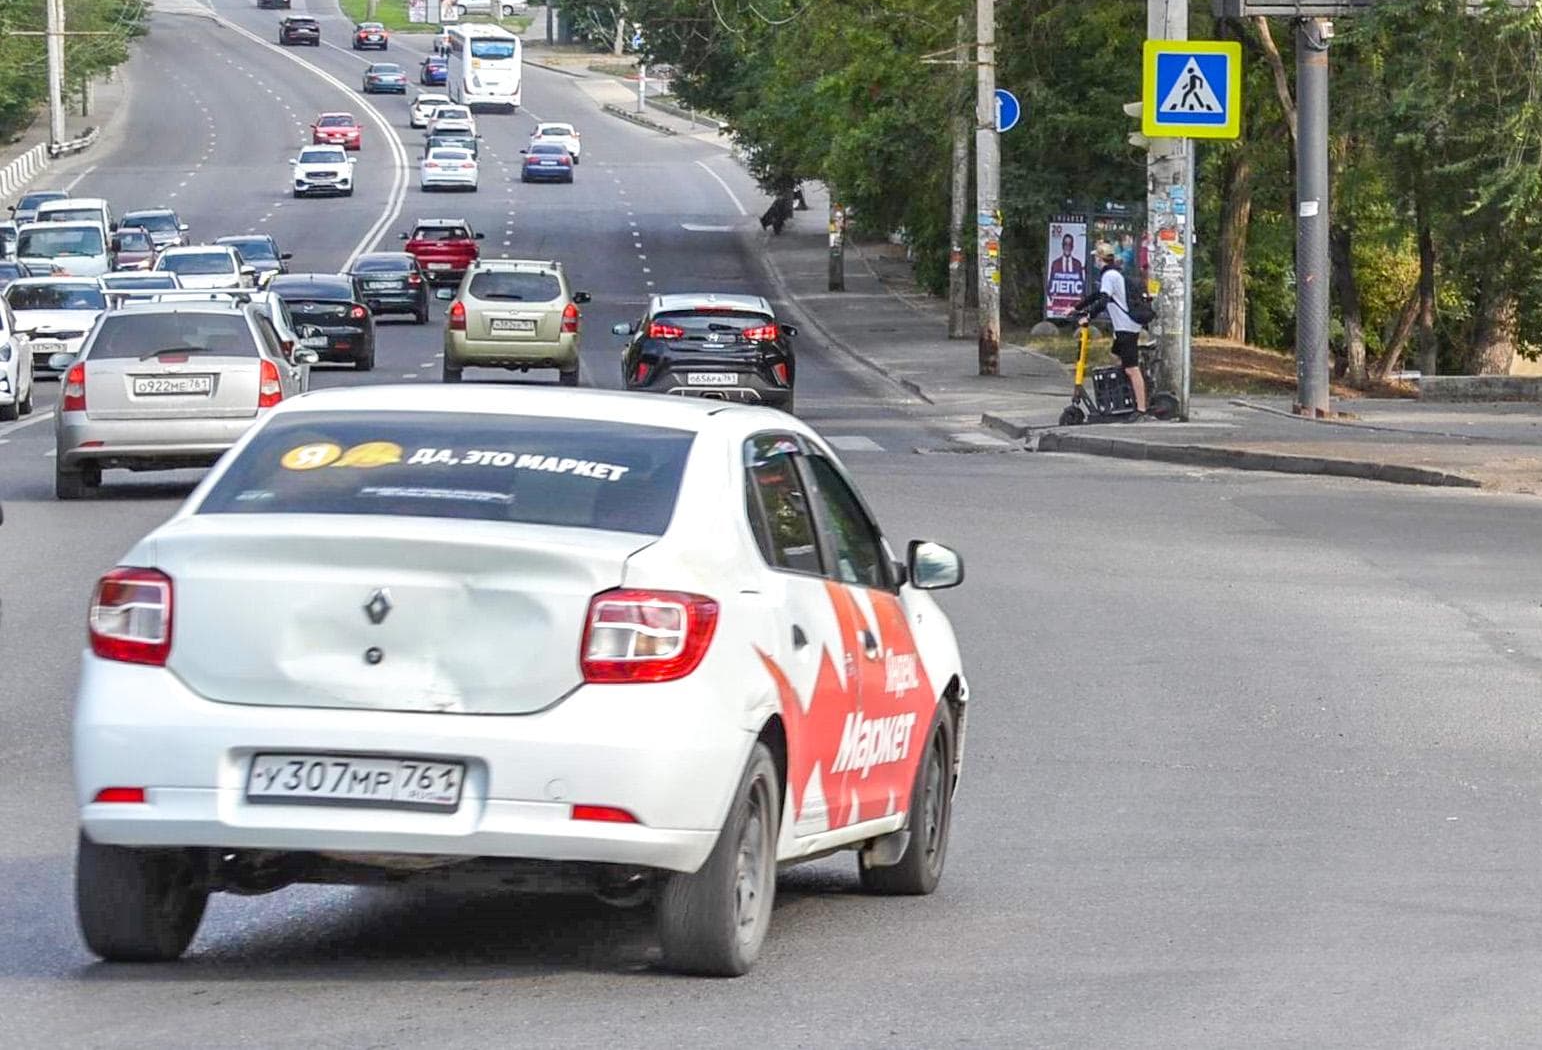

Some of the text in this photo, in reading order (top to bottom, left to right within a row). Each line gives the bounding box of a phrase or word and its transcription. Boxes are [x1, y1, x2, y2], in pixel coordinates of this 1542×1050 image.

[1050, 281, 1083, 294] ЛЕПС
[407, 447, 458, 466] ДА,
[463, 451, 518, 468] ЭТО
[514, 454, 630, 482] МАРКЕТ
[830, 711, 917, 780] Маркет
[264, 761, 456, 795] У307МР 761
